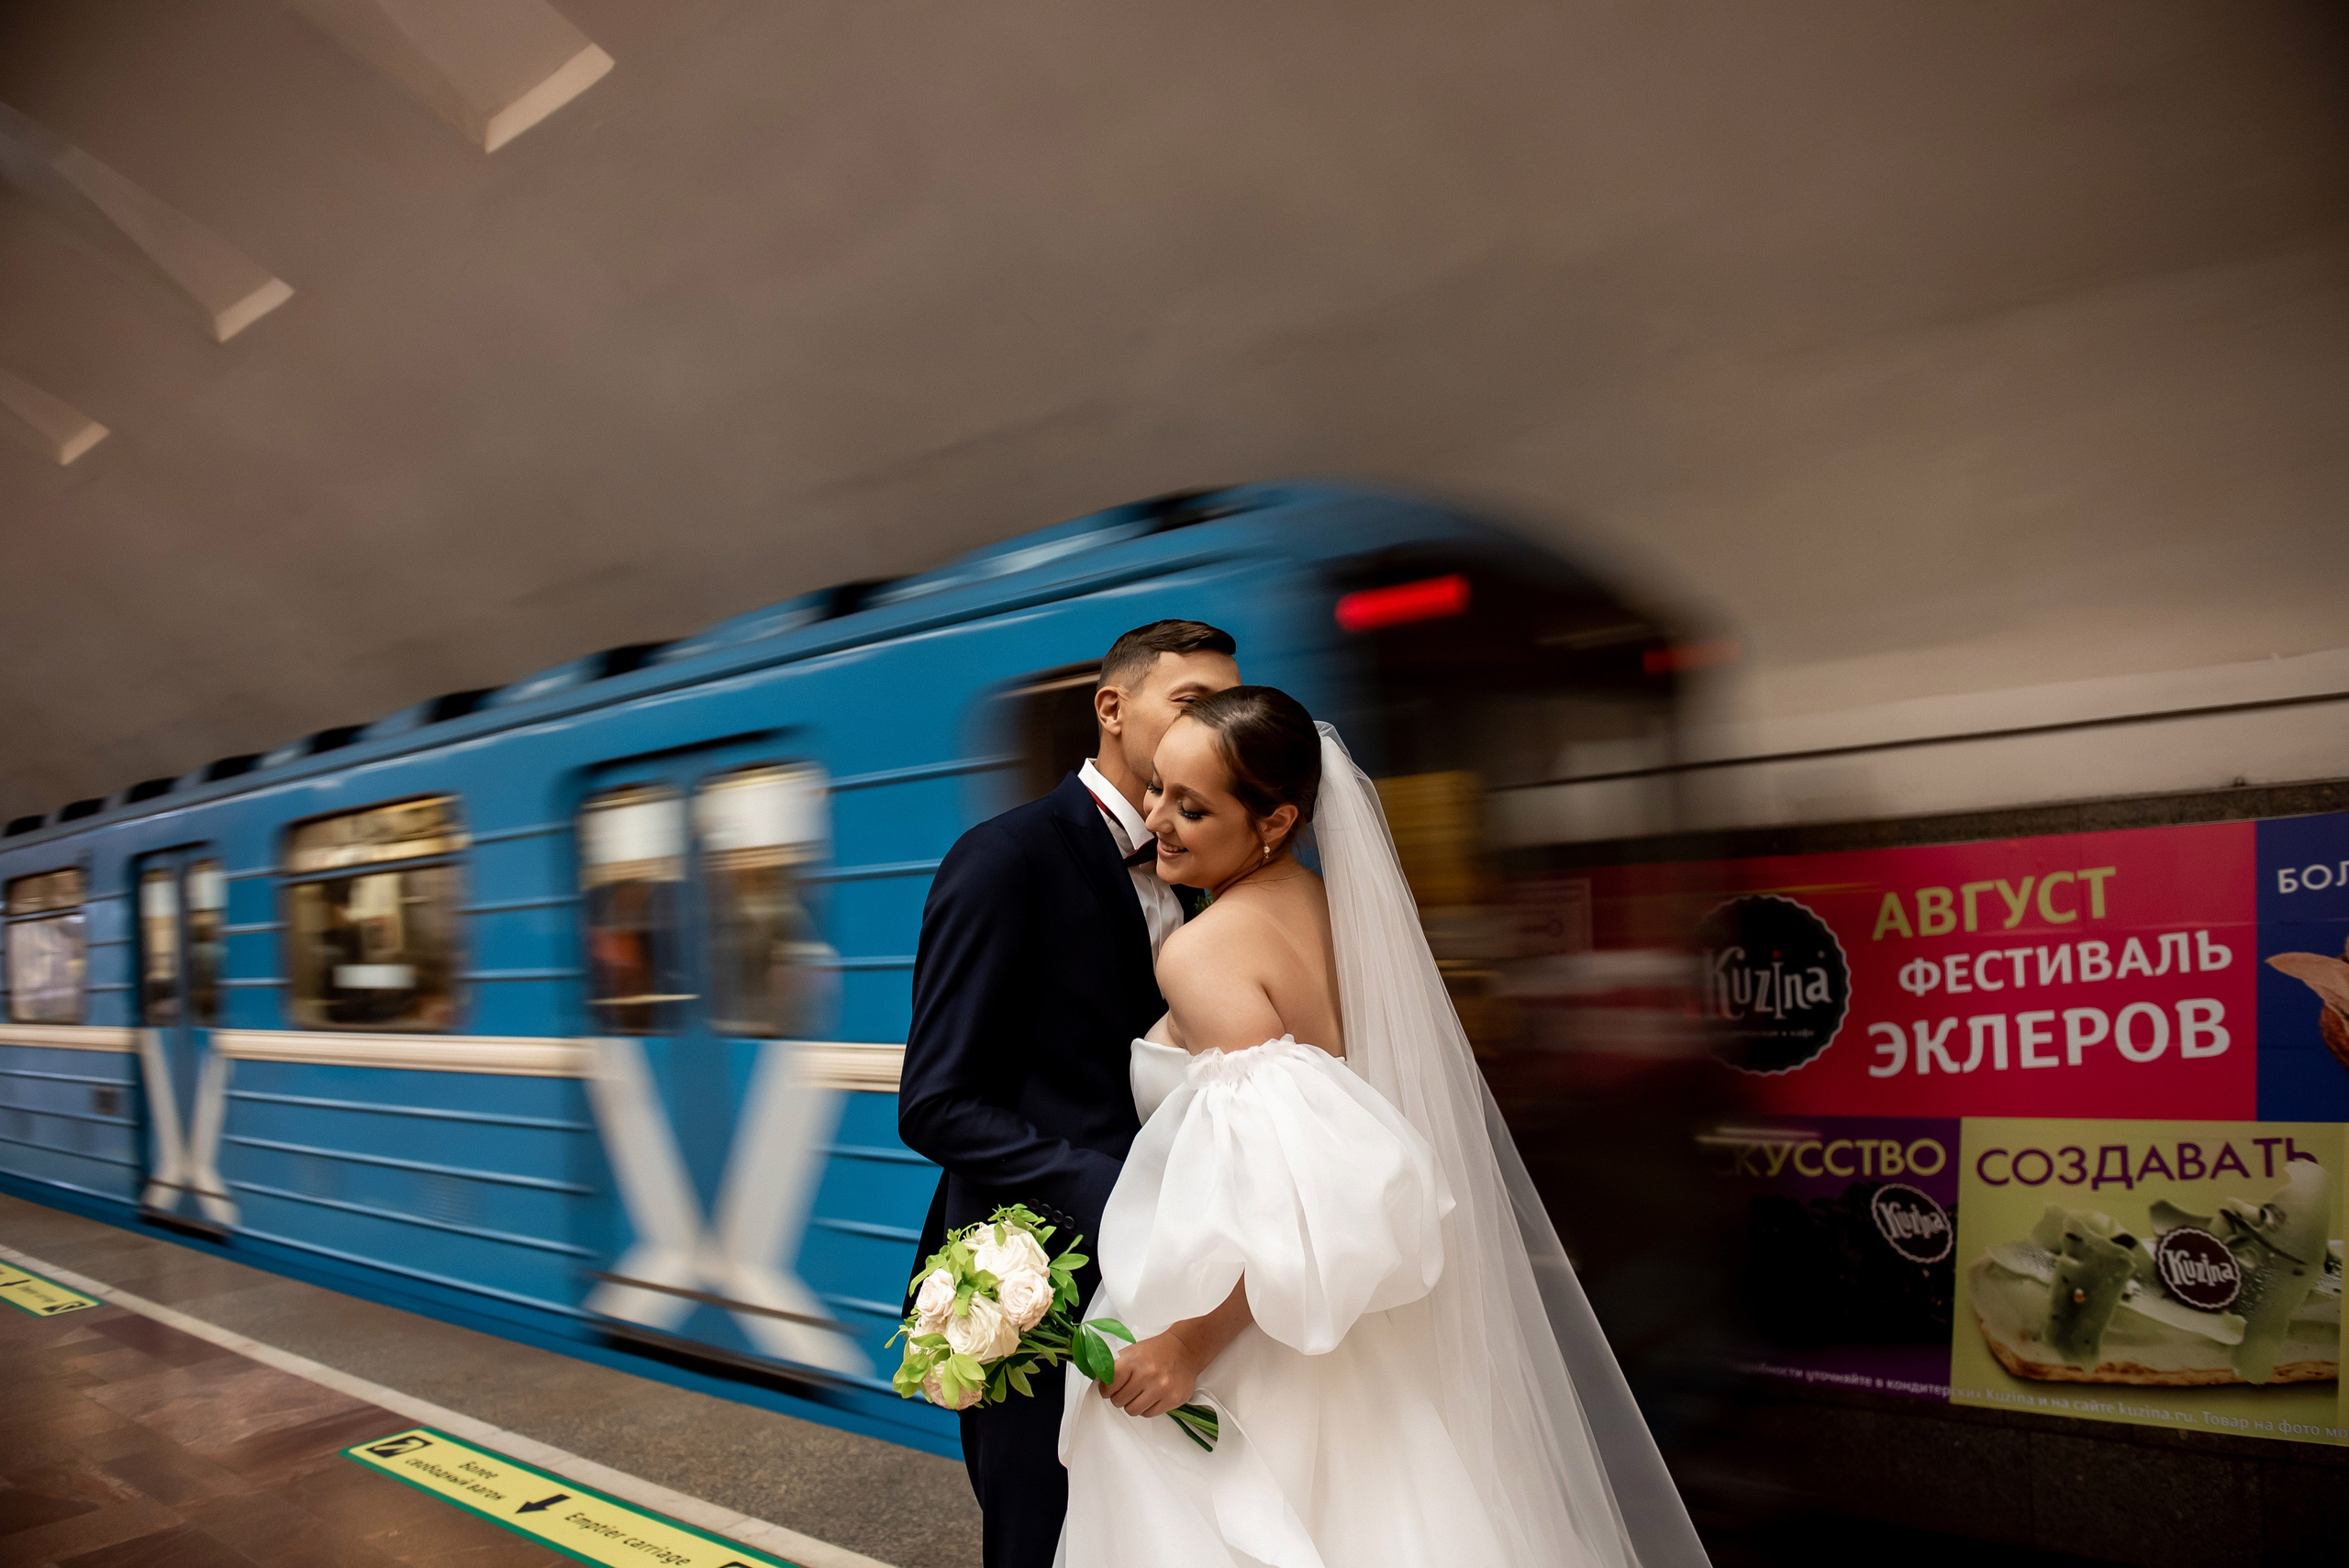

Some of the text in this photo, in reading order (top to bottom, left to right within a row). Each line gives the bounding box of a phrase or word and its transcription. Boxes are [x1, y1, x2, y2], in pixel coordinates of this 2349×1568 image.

[1872, 866, 2116, 940] АВГУСТ
[1898, 929, 2232, 997] ФЕСТИВАЛЬ
[1867, 998, 2231, 1078] ЭКЛЕРОВ
[1716, 1138, 1947, 1178] КУССТВО
[1877, 1201, 1947, 1239] Kuzina
[2165, 1249, 2237, 1286] Kuzina
[2051, 1397, 2069, 1408] на
[2073, 1399, 2114, 1413] сайте
[2202, 1410, 2249, 1430] Товар
[2254, 1420, 2275, 1431] на
[2278, 1418, 2321, 1436] фото
[564, 1512, 690, 1565] Emptier carriage
